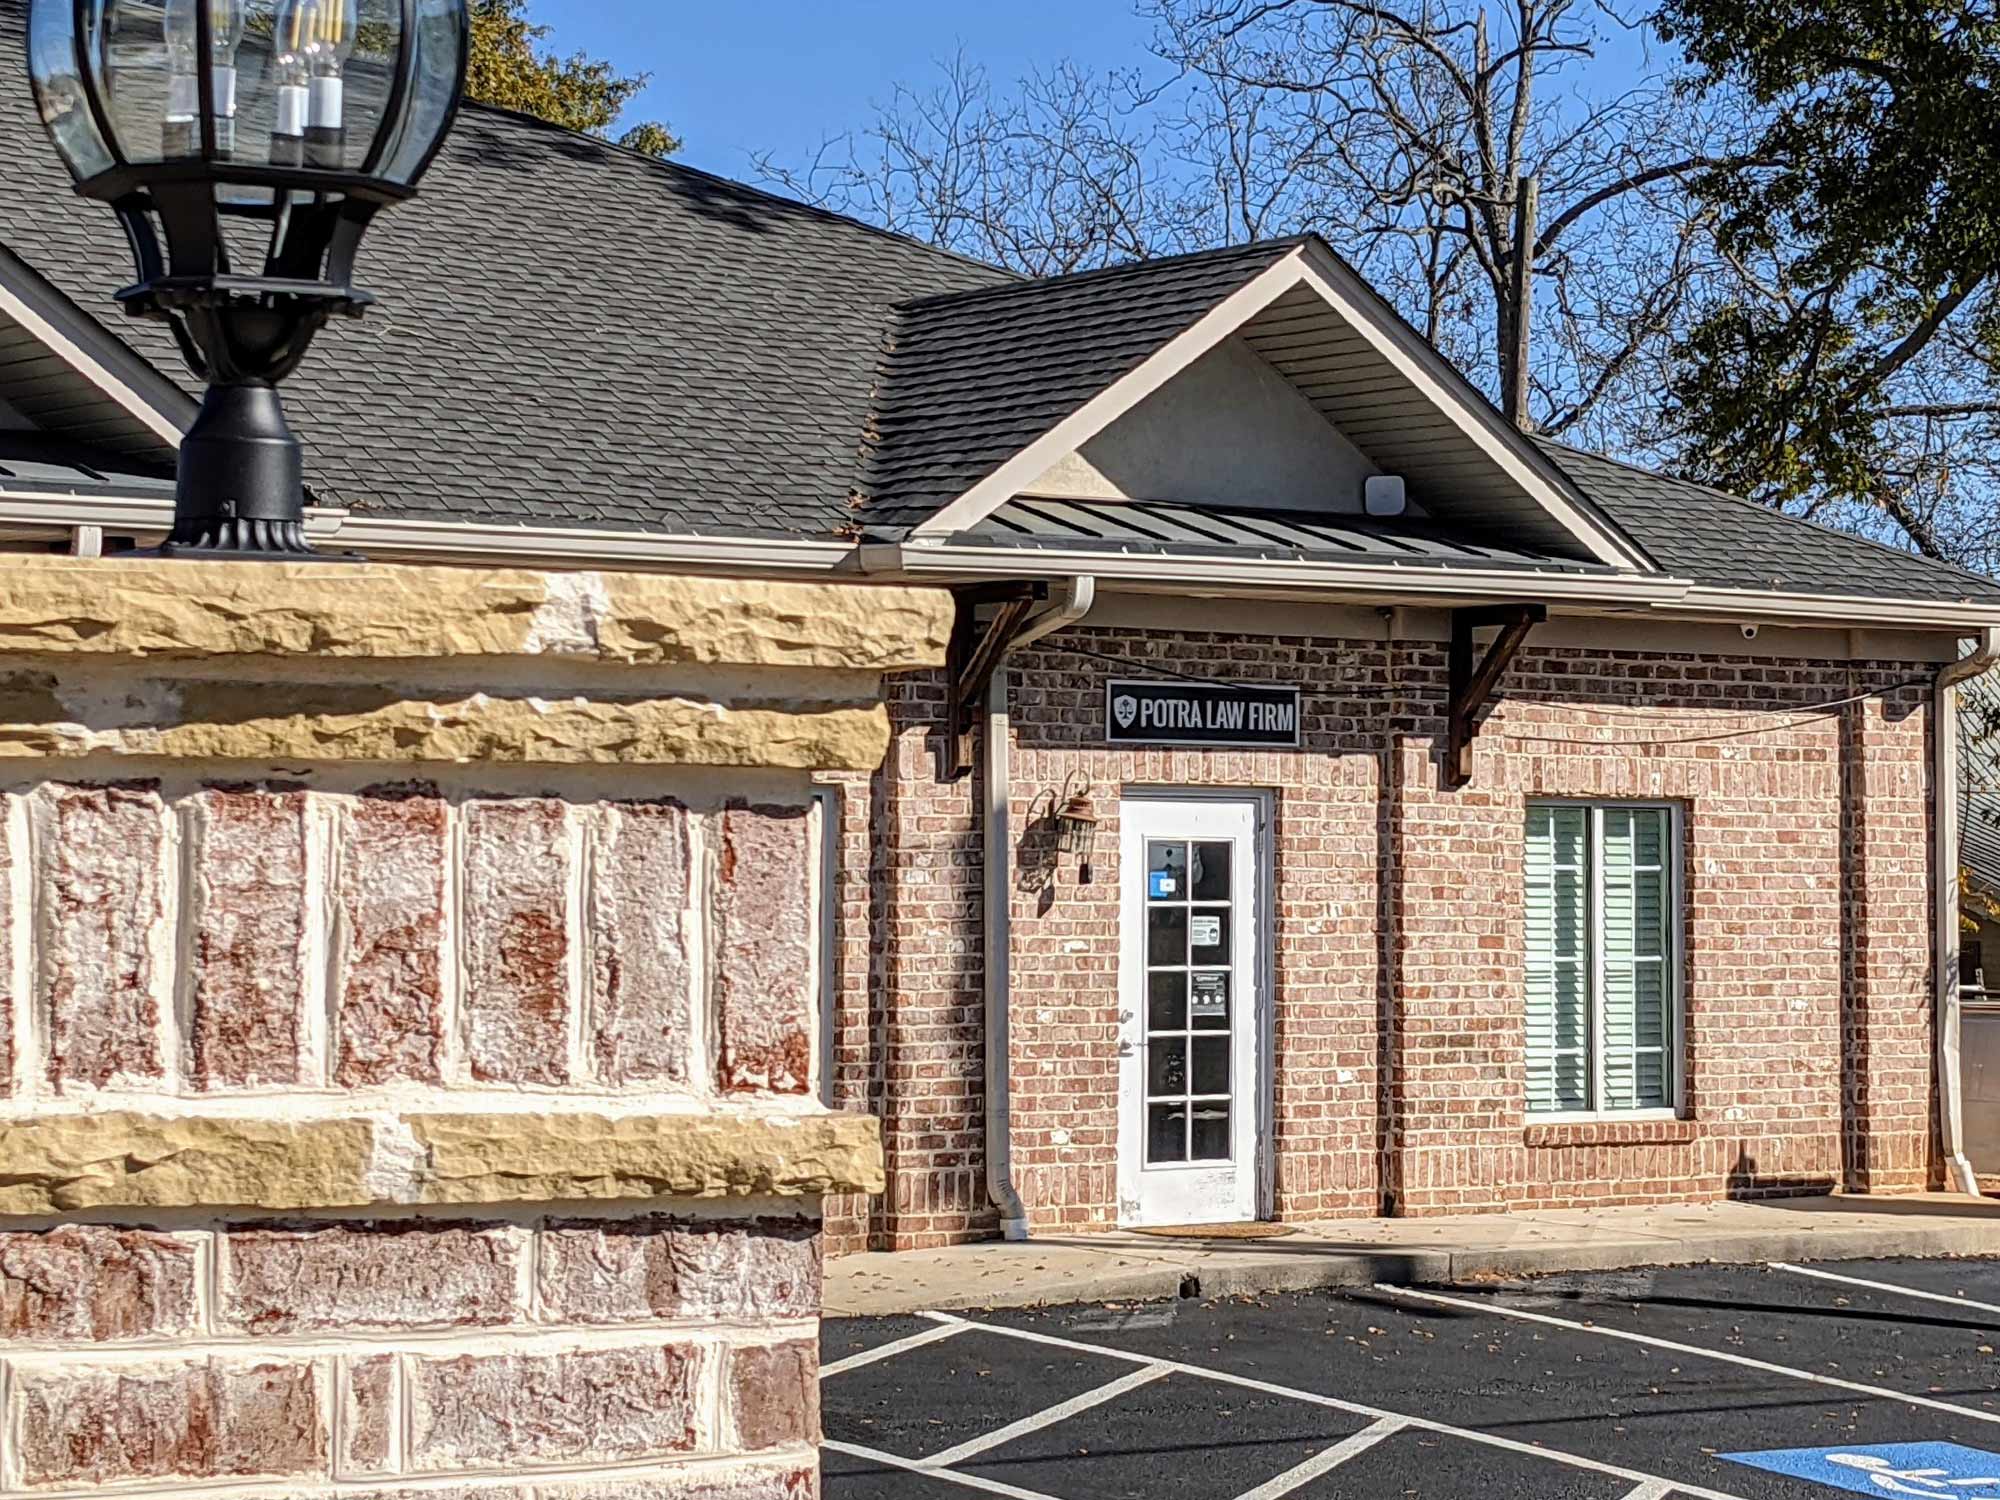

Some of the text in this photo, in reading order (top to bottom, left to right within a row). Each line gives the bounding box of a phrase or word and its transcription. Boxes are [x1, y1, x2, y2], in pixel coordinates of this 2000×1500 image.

[1140, 699, 1293, 731] POTRA LAW FIRM
